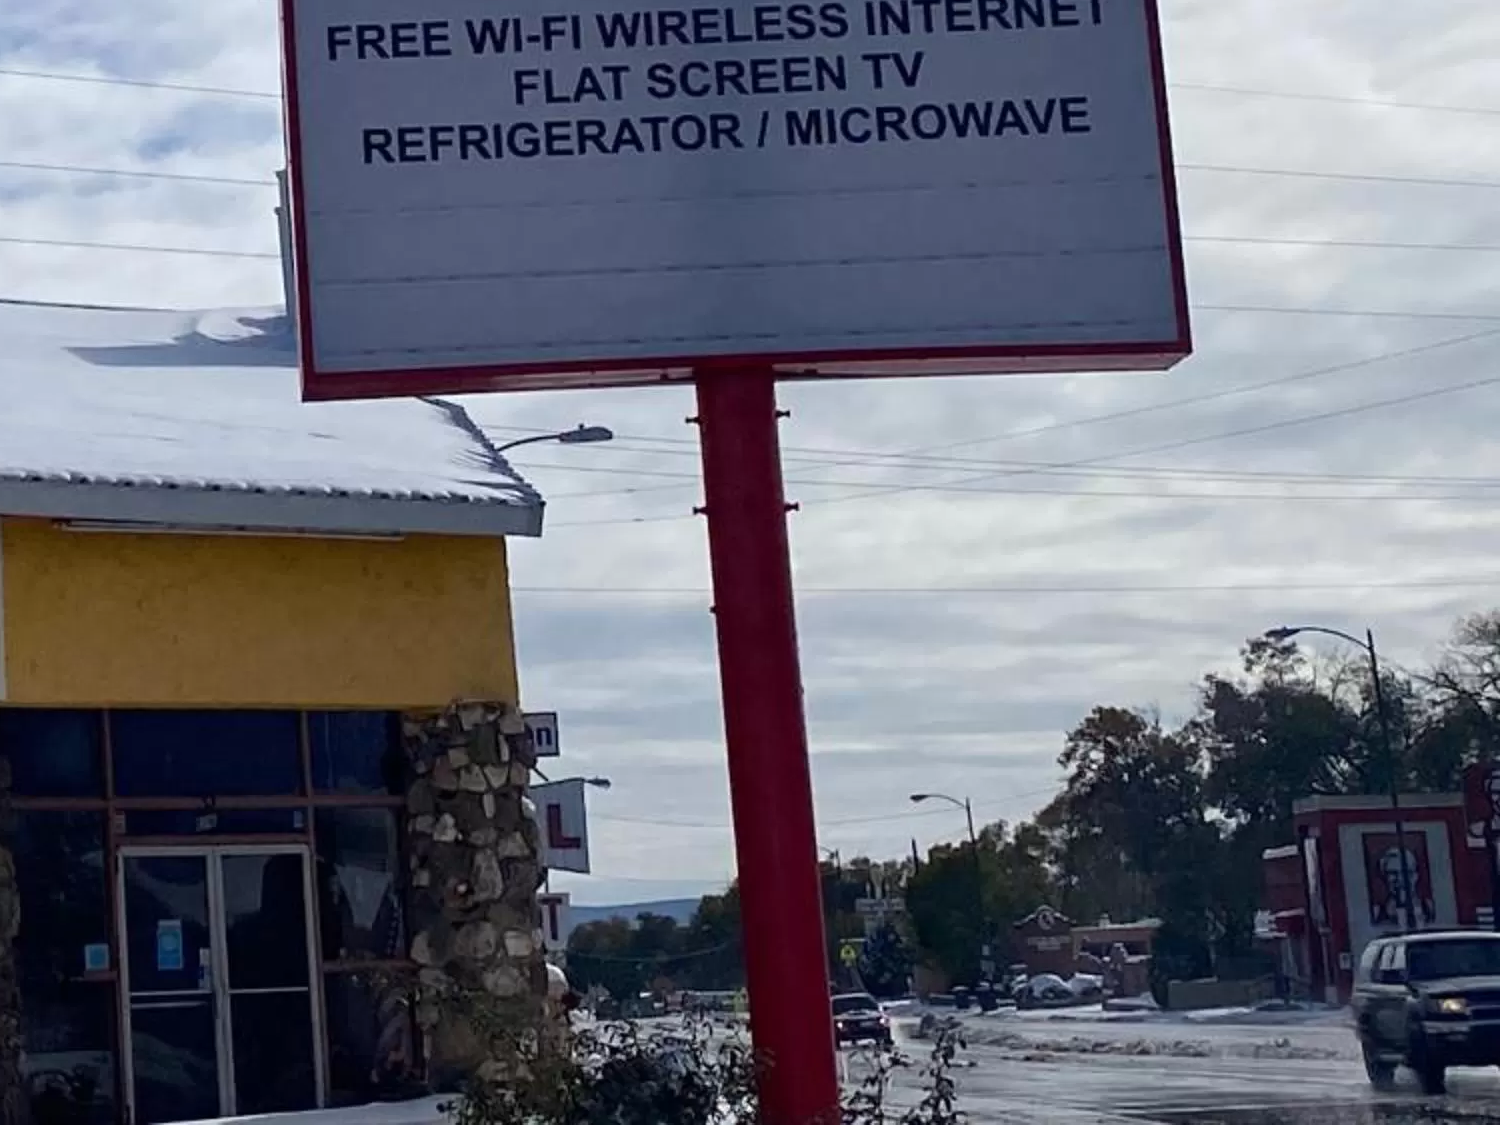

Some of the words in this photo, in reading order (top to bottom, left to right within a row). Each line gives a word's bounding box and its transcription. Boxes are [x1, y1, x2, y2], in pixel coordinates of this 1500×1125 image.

[326, 20, 452, 61] FREE
[464, 14, 582, 55] WI-FI
[595, 1, 849, 49] WIRELESS
[513, 65, 631, 106] FLAT
[646, 55, 847, 100] SCREEN
[861, 51, 925, 89] TV
[362, 113, 744, 165] REFRIGERATOR
[757, 118, 769, 149] /
[785, 96, 1091, 147] MICROWAVE
